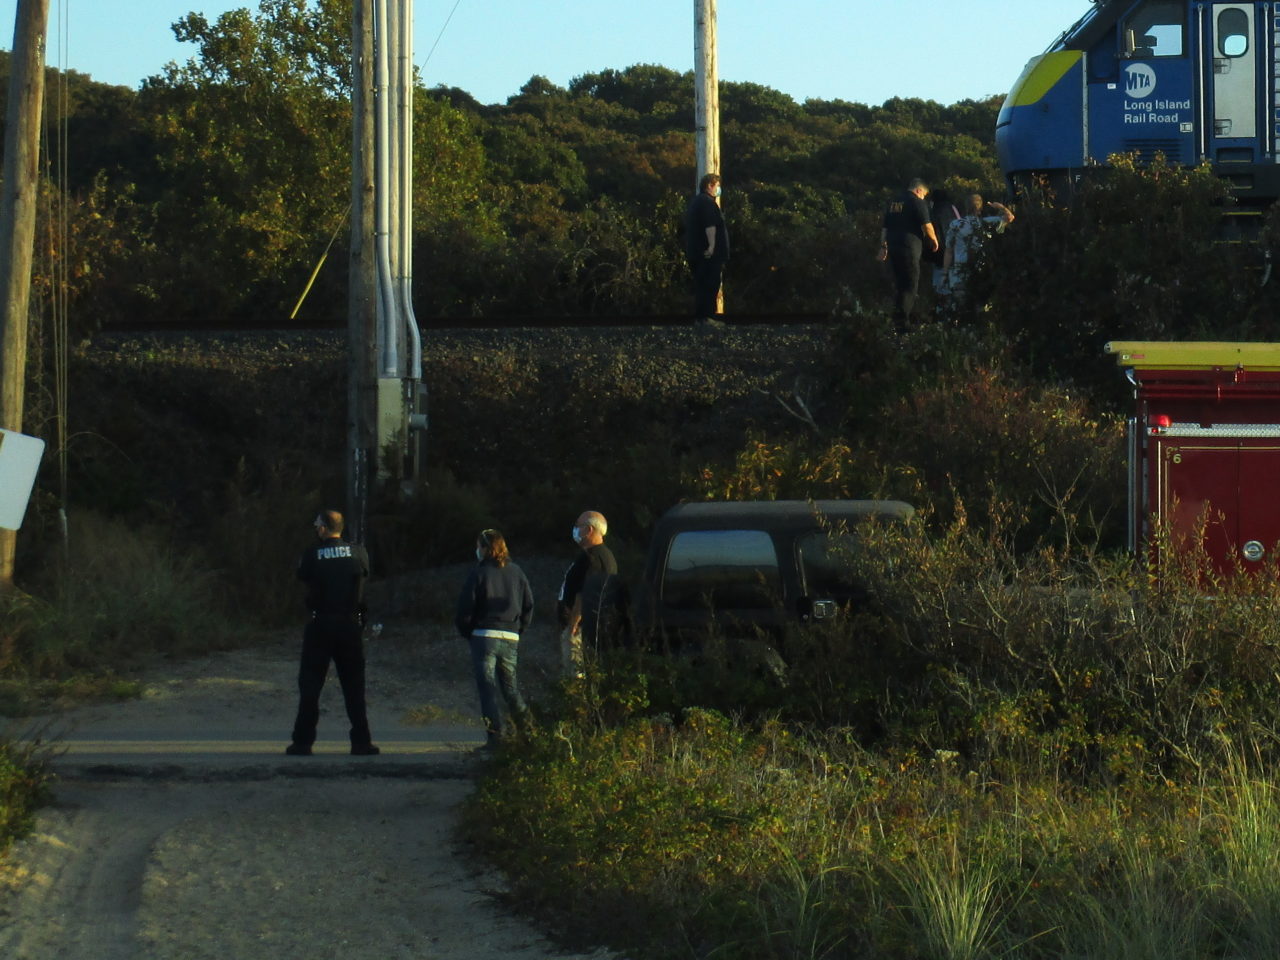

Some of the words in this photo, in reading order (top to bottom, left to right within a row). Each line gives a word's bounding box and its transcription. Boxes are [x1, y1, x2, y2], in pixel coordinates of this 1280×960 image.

[1124, 100, 1153, 112] Long
[1155, 100, 1191, 109] Island
[1124, 113, 1146, 123] Rail
[1148, 113, 1178, 123] Road
[1173, 453, 1181, 464] 6
[317, 546, 352, 560] POLICE
